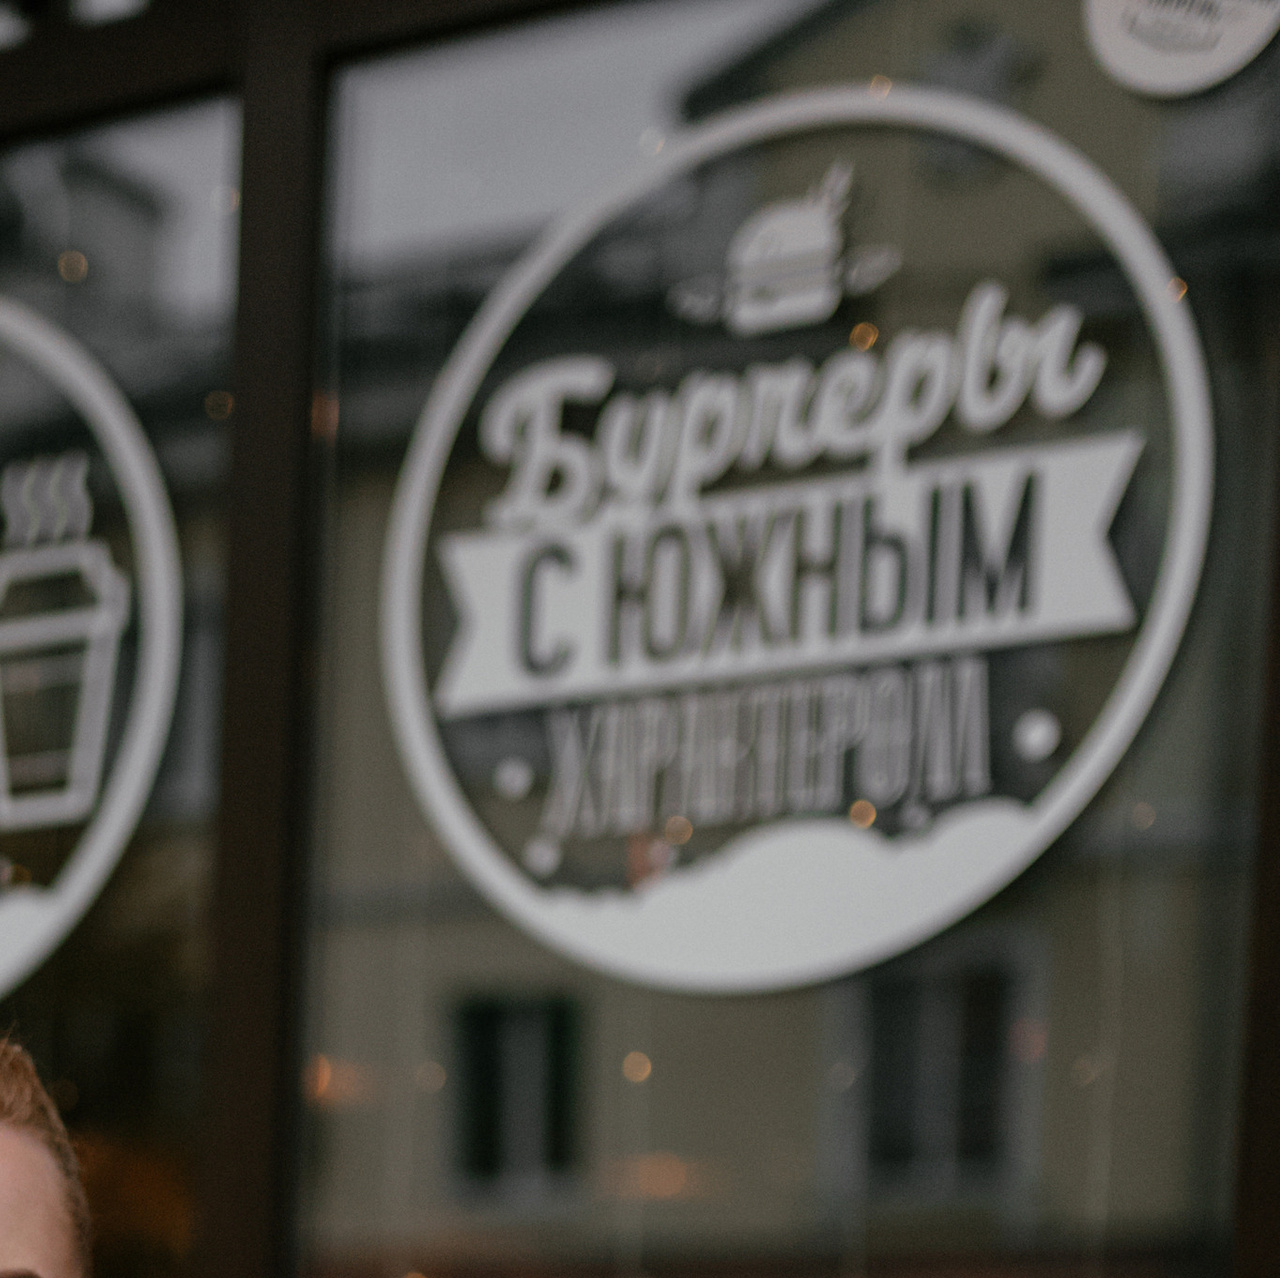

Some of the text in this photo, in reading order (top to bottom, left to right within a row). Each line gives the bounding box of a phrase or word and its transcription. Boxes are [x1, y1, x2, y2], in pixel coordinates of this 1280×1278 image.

[478, 282, 1106, 534] Бургеры
[519, 465, 1042, 682] С ЮЖНЫМ
